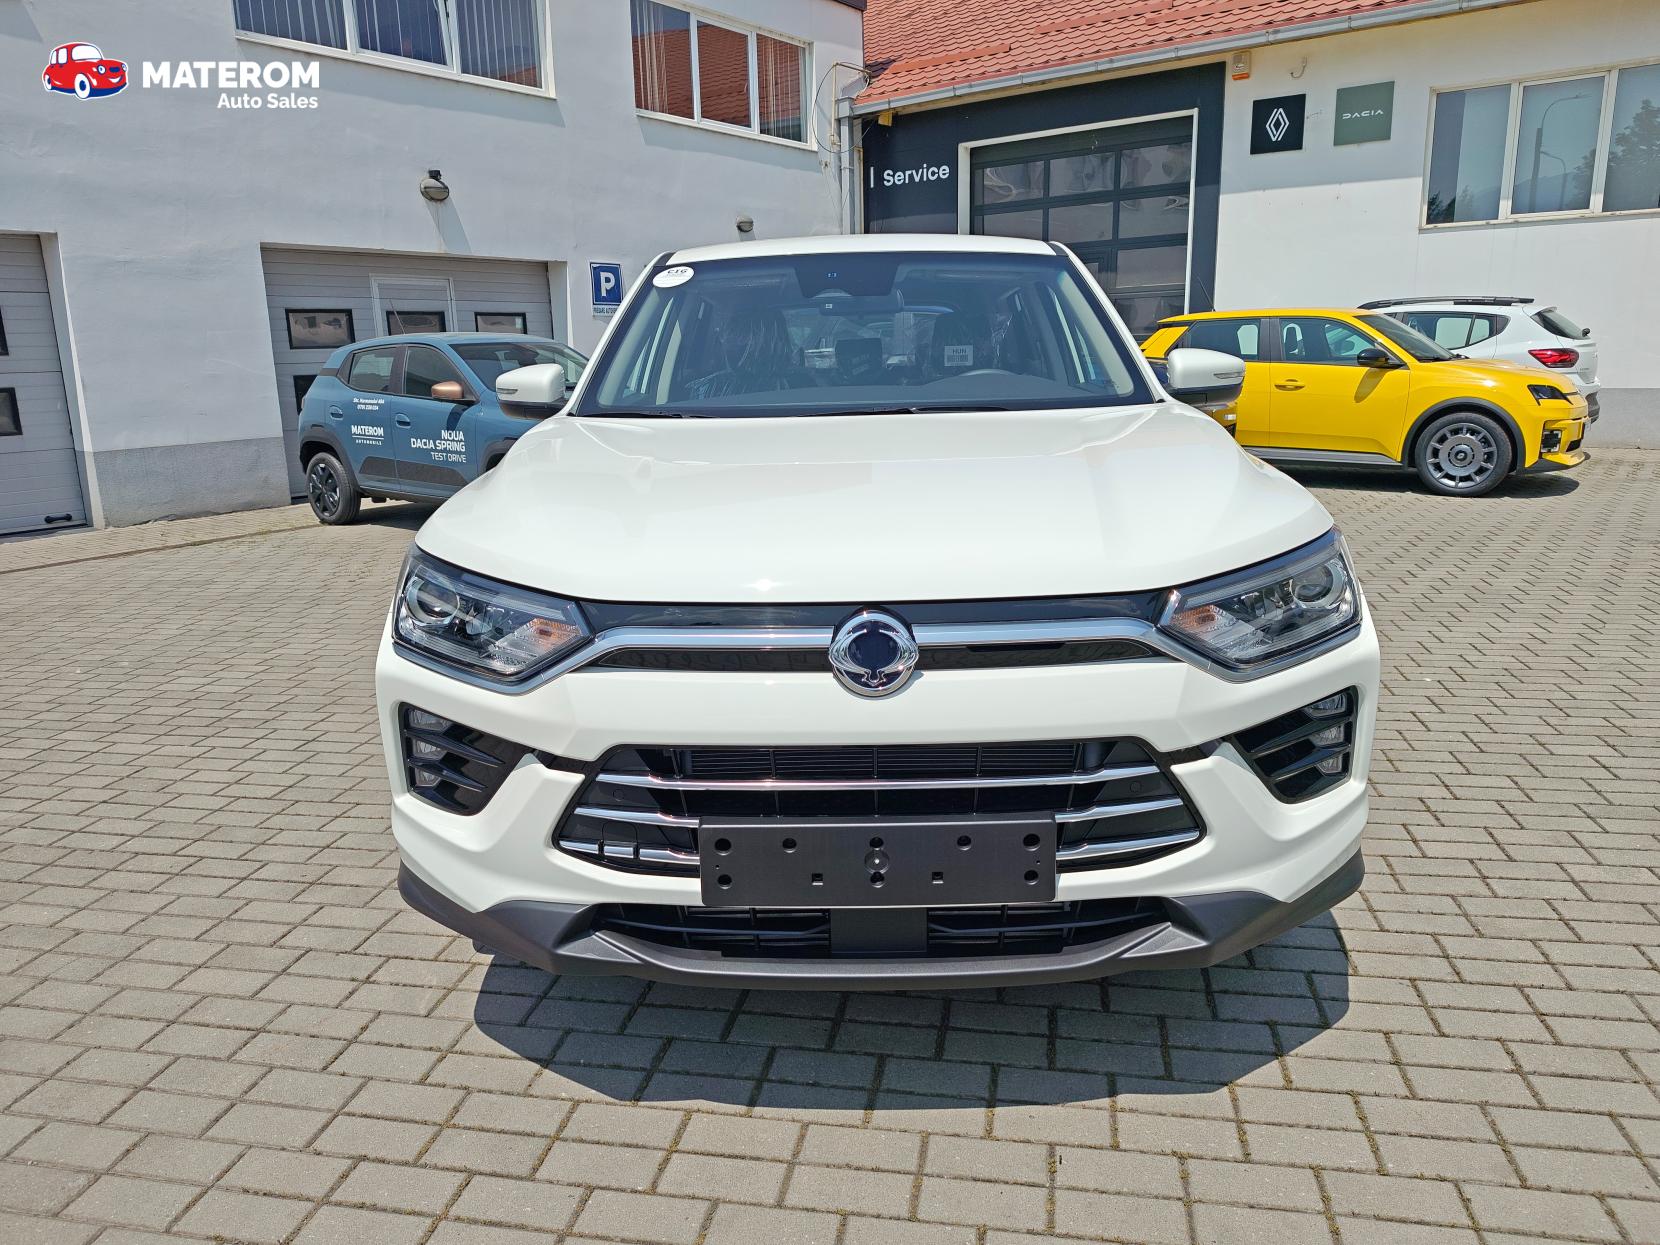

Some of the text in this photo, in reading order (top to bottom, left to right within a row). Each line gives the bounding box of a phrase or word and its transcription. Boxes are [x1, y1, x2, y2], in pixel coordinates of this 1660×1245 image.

[1342, 110, 1384, 119] DACIA
[883, 163, 950, 187] Service
[599, 271, 616, 297] P
[351, 424, 384, 436] MATEROM
[441, 429, 465, 441] NOUA
[410, 437, 466, 452] DACIA SPRING
[430, 451, 467, 463] TEST DRIVE
